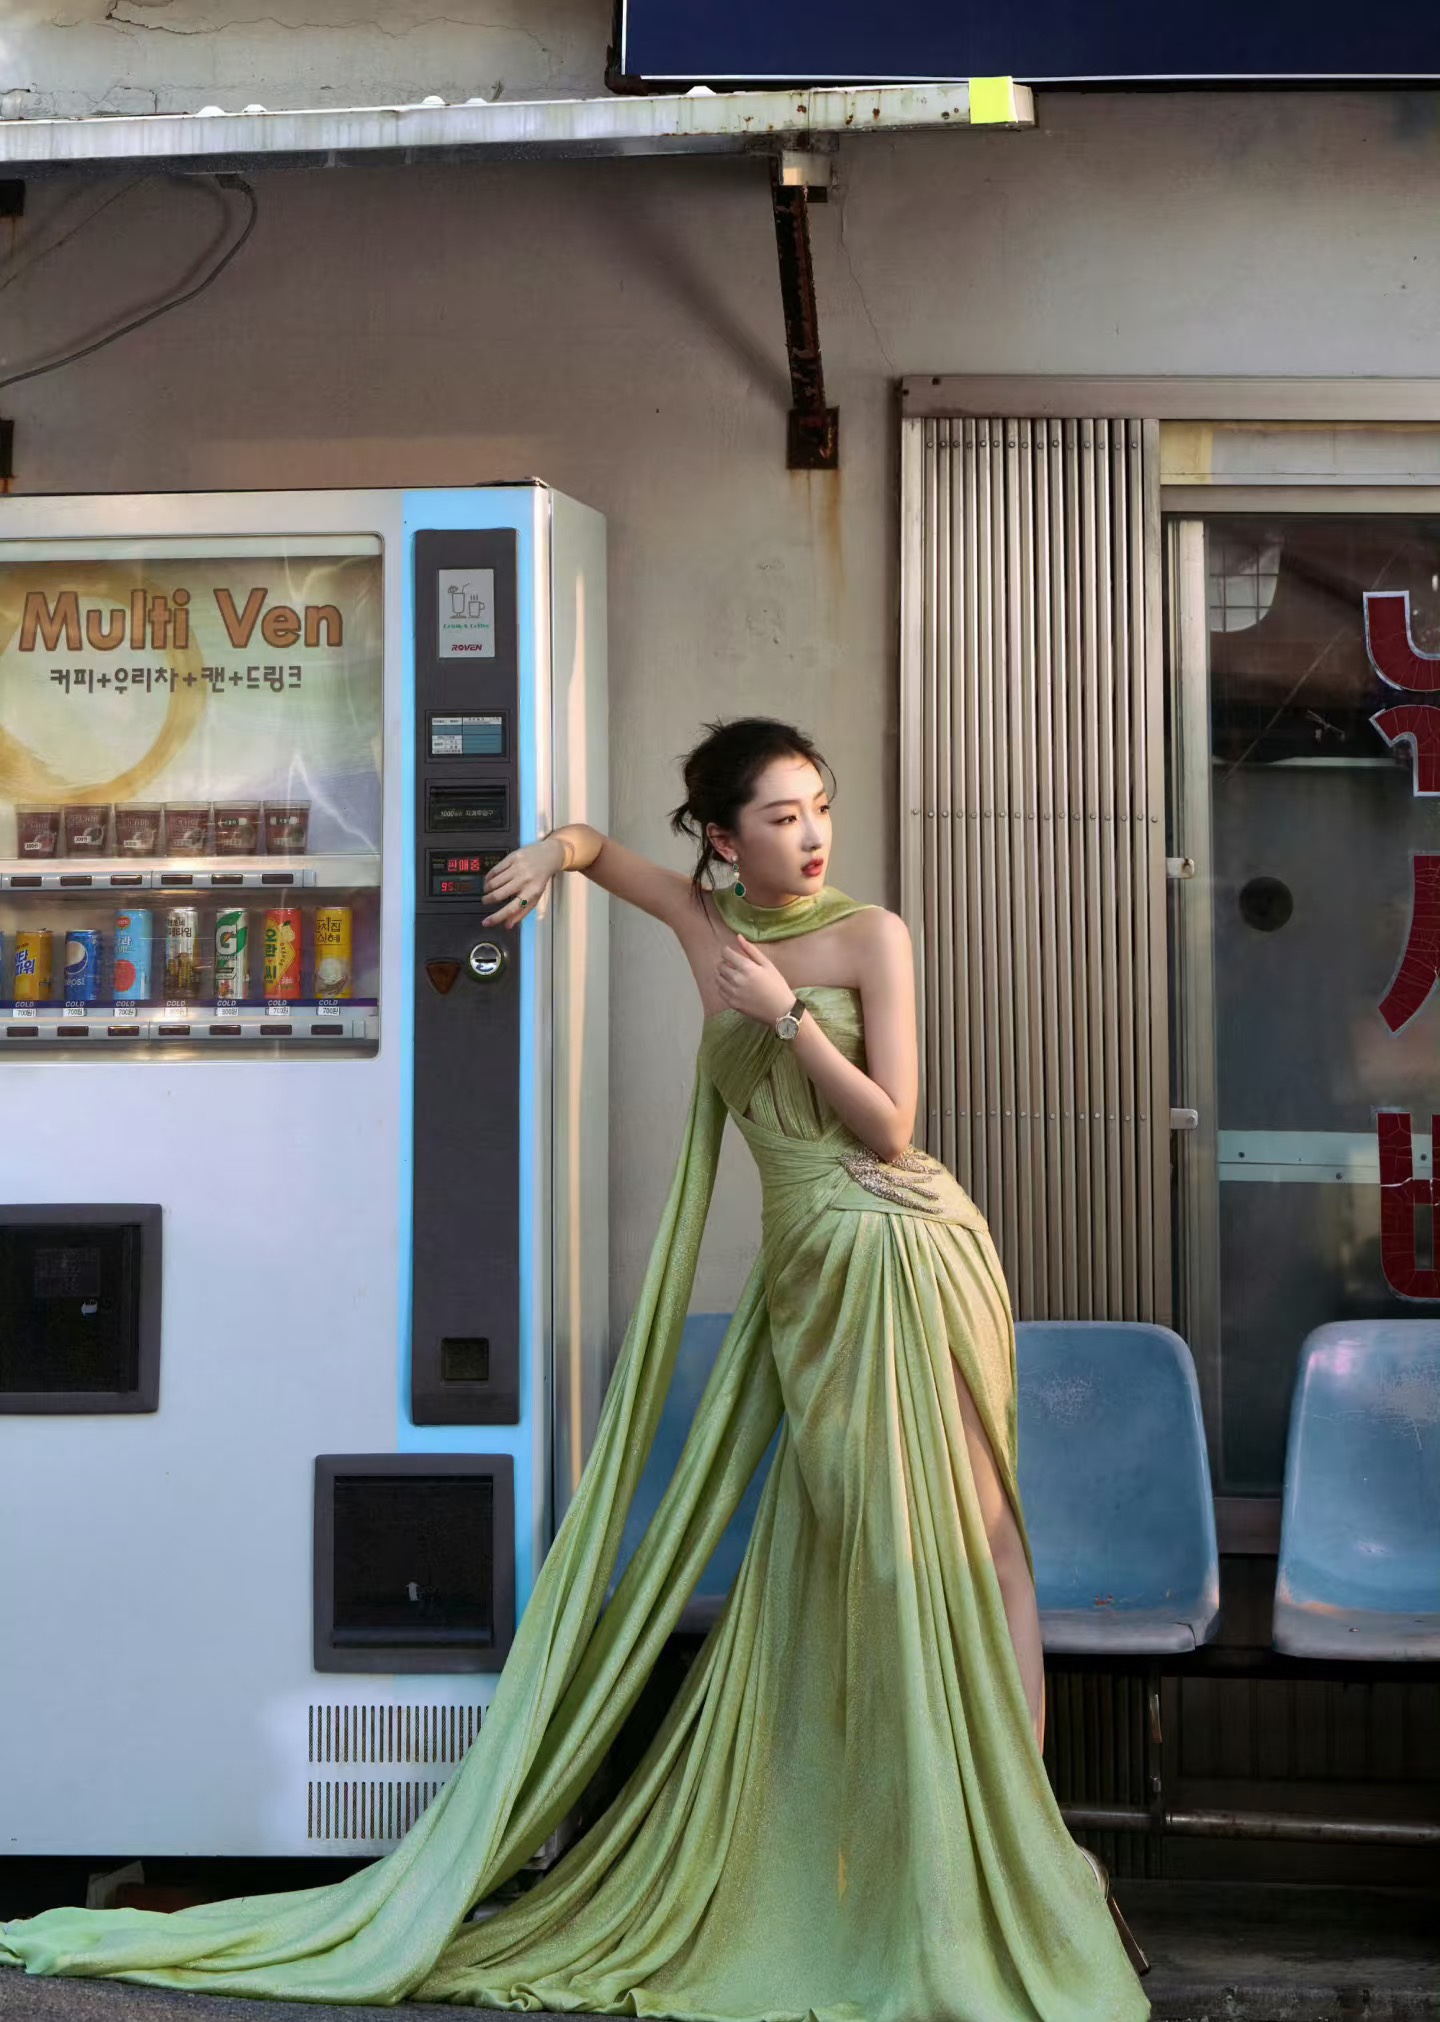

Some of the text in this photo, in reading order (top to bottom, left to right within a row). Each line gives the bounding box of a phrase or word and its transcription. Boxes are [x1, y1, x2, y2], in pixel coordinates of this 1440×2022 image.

[19, 588, 343, 651] Multi Ven
[447, 859, 480, 872] 판매중
[65, 978, 86, 987] epsi
